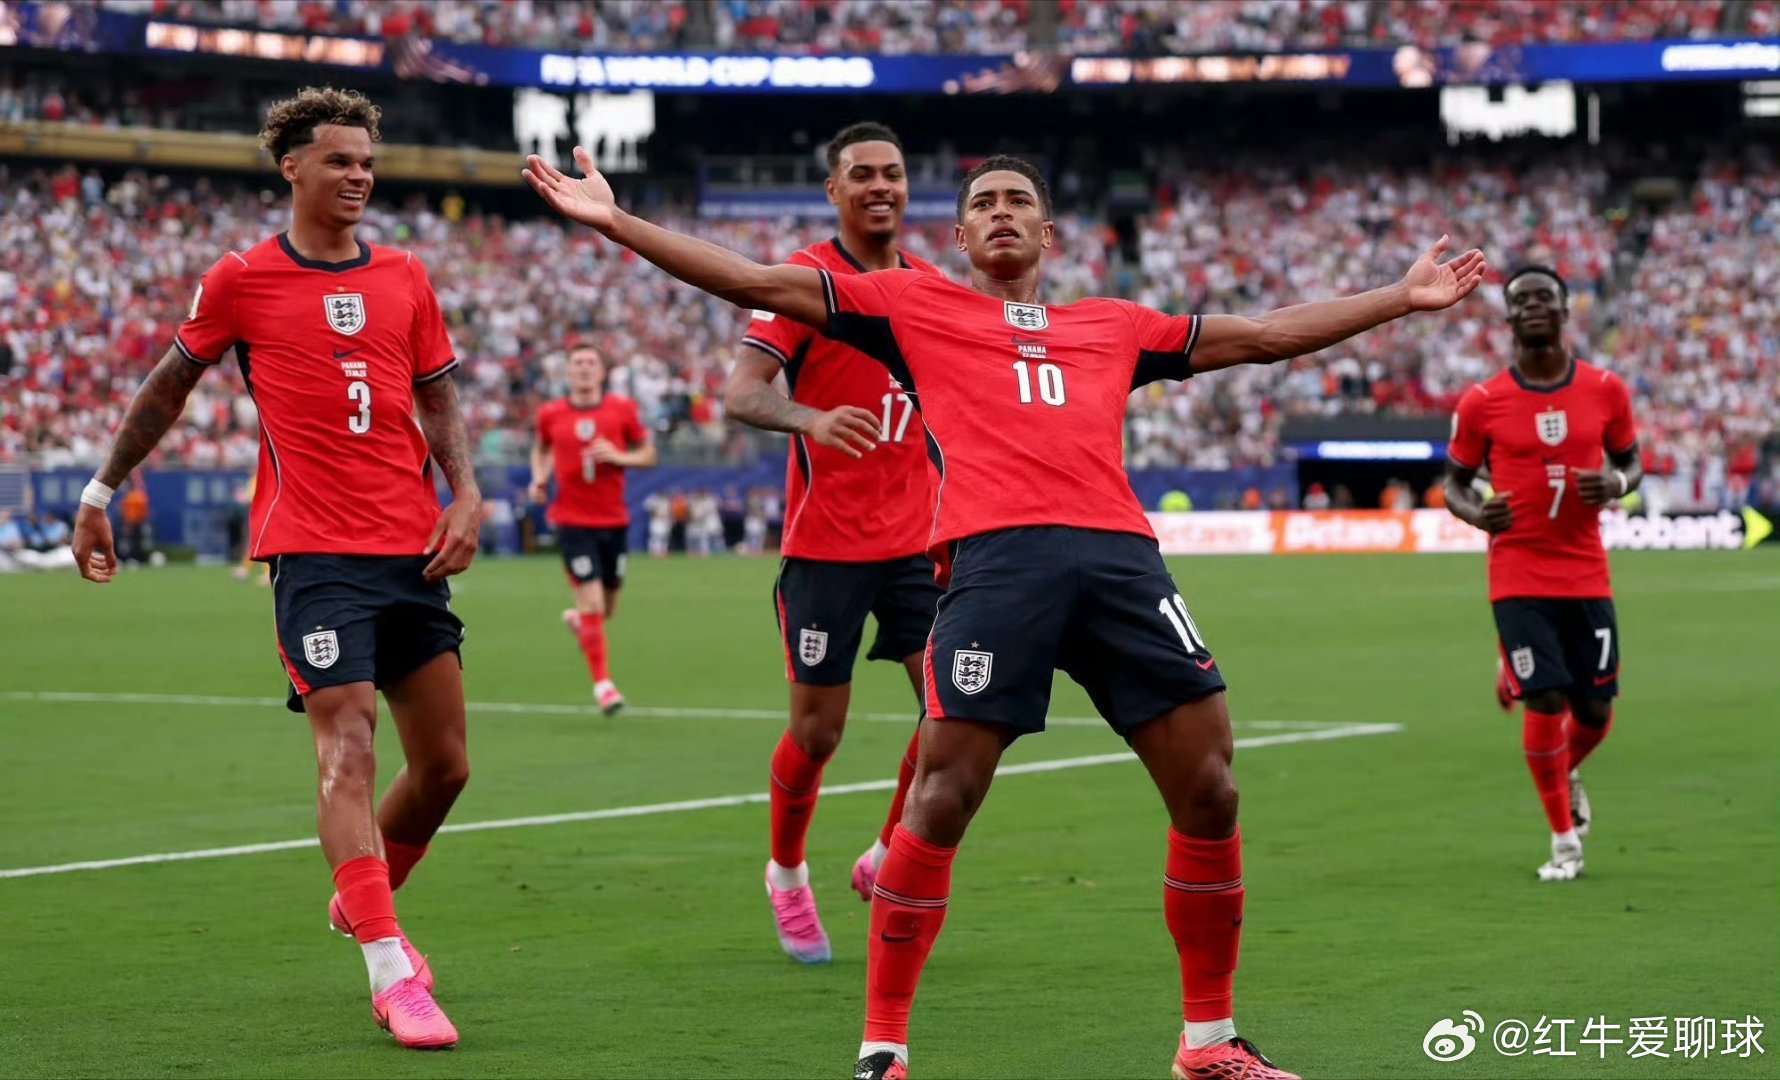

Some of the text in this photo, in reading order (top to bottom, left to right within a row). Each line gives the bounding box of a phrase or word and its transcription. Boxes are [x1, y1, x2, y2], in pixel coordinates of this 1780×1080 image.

[347, 381, 371, 434] 3
[1012, 361, 1066, 407] 10
[879, 393, 914, 442] 17
[1548, 479, 1566, 519] 7
[1158, 593, 1206, 654] 10
[1594, 627, 1611, 671] 7
